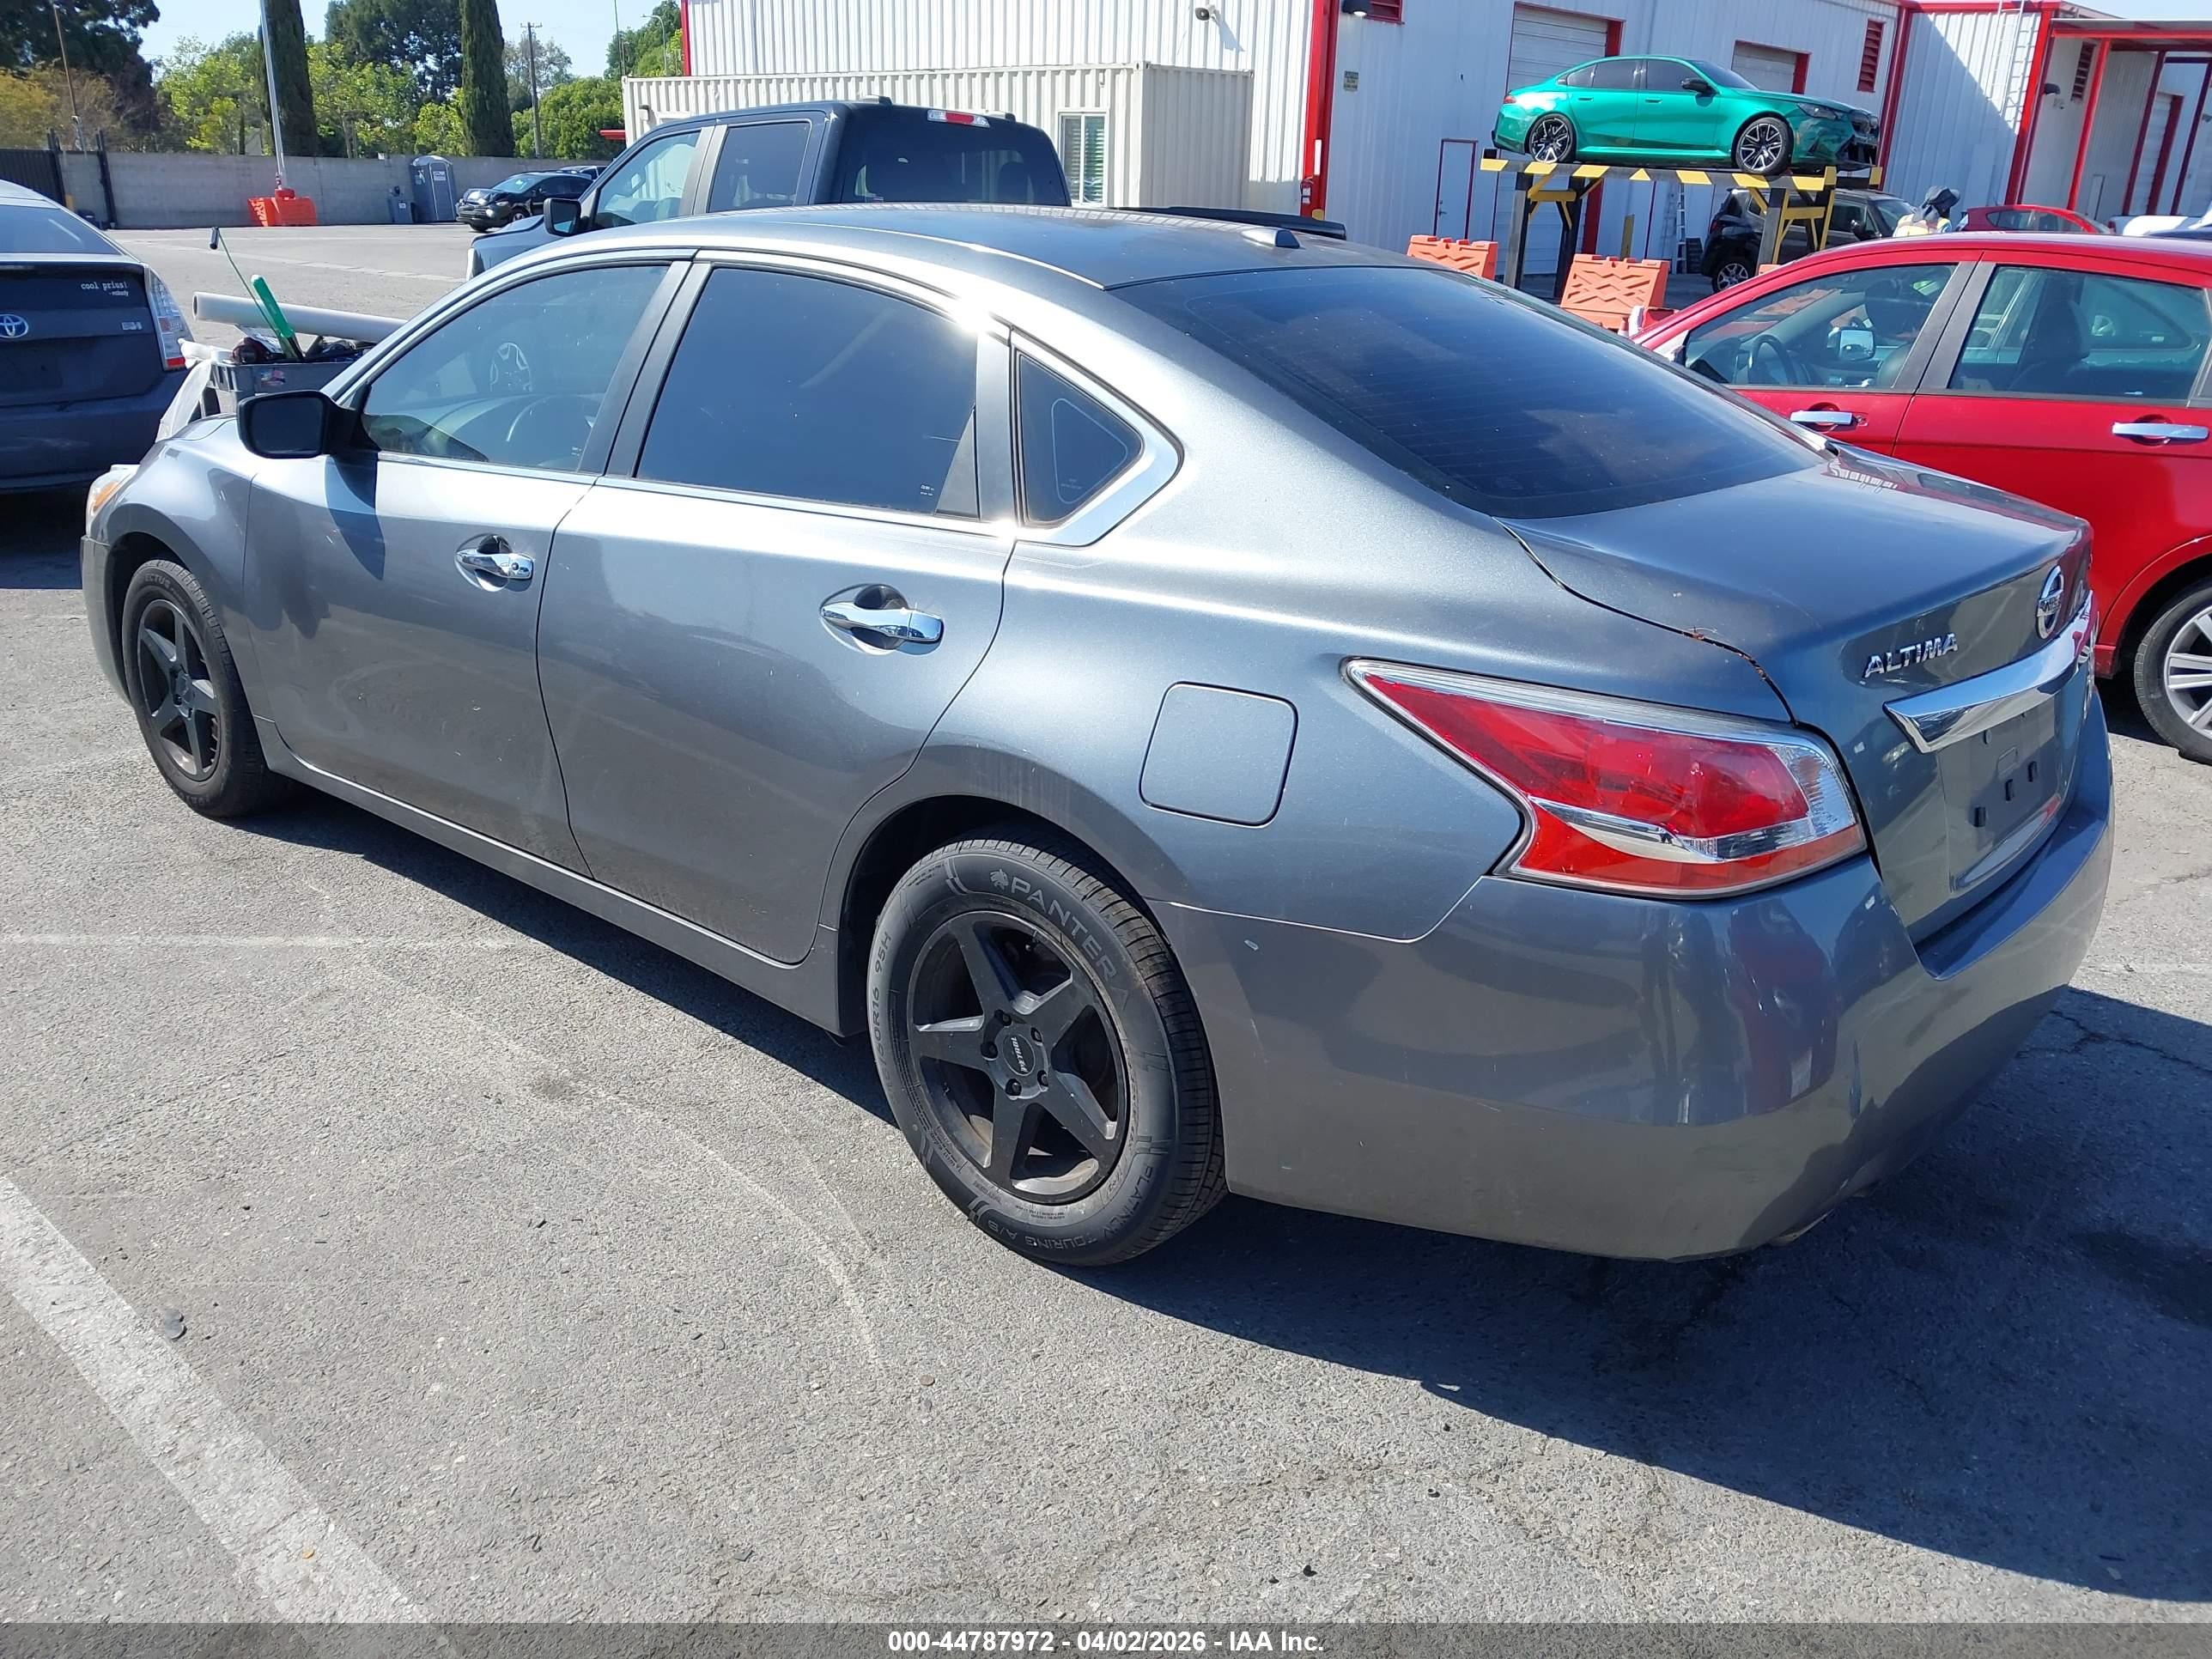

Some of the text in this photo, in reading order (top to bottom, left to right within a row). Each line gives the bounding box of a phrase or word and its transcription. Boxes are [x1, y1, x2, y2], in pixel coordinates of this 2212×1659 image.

[1864, 633, 1959, 678] ALTIMA
[875, 931, 892, 975] 95H
[1024, 1231, 1099, 1250] TOURING
